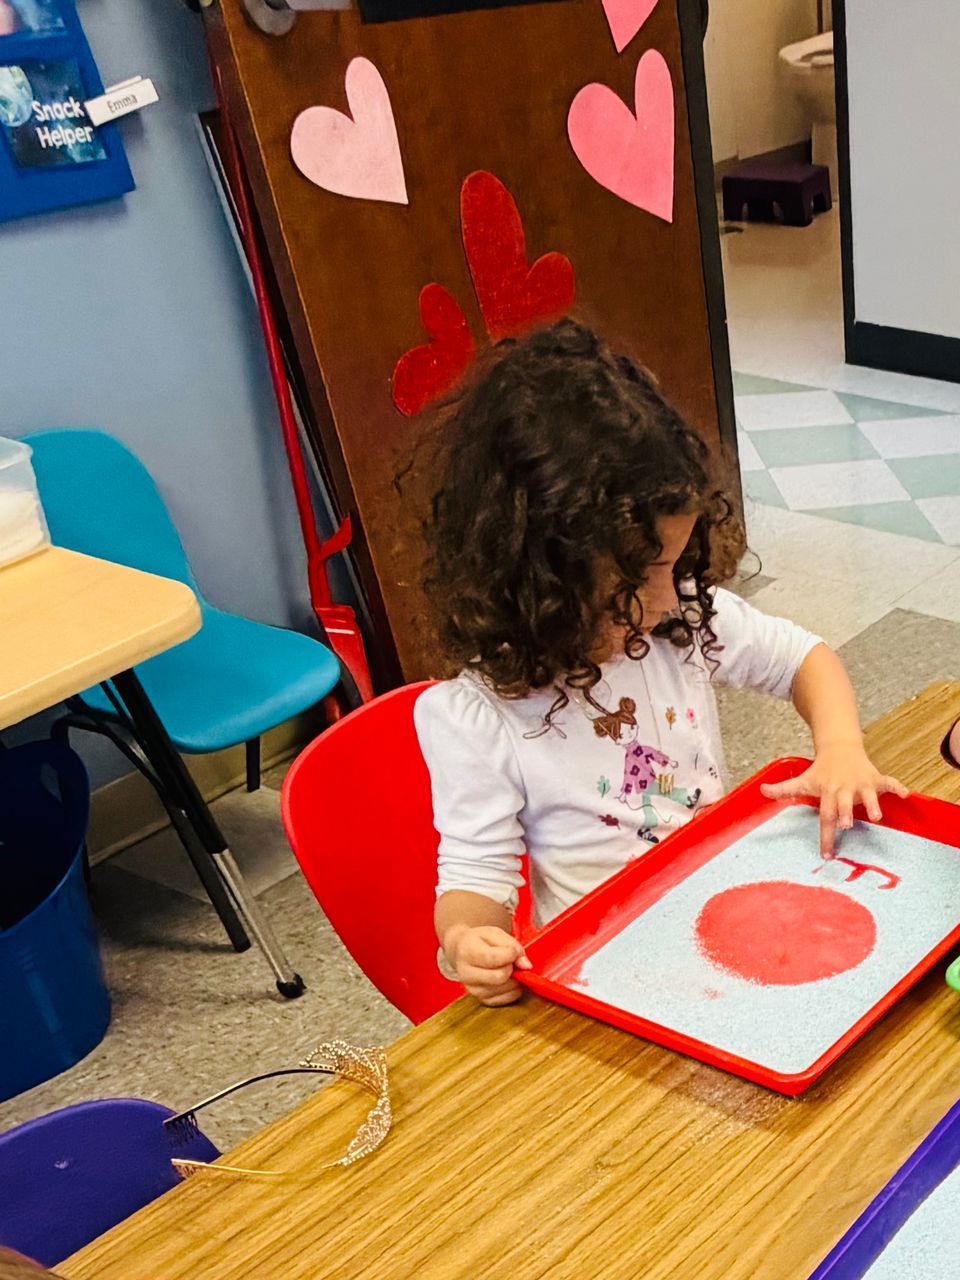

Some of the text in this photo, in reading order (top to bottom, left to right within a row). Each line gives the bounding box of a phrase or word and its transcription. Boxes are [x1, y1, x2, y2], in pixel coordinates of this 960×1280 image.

[31, 96, 85, 122] Snack
[106, 93, 138, 113] Emma
[36, 124, 94, 149] Helper
